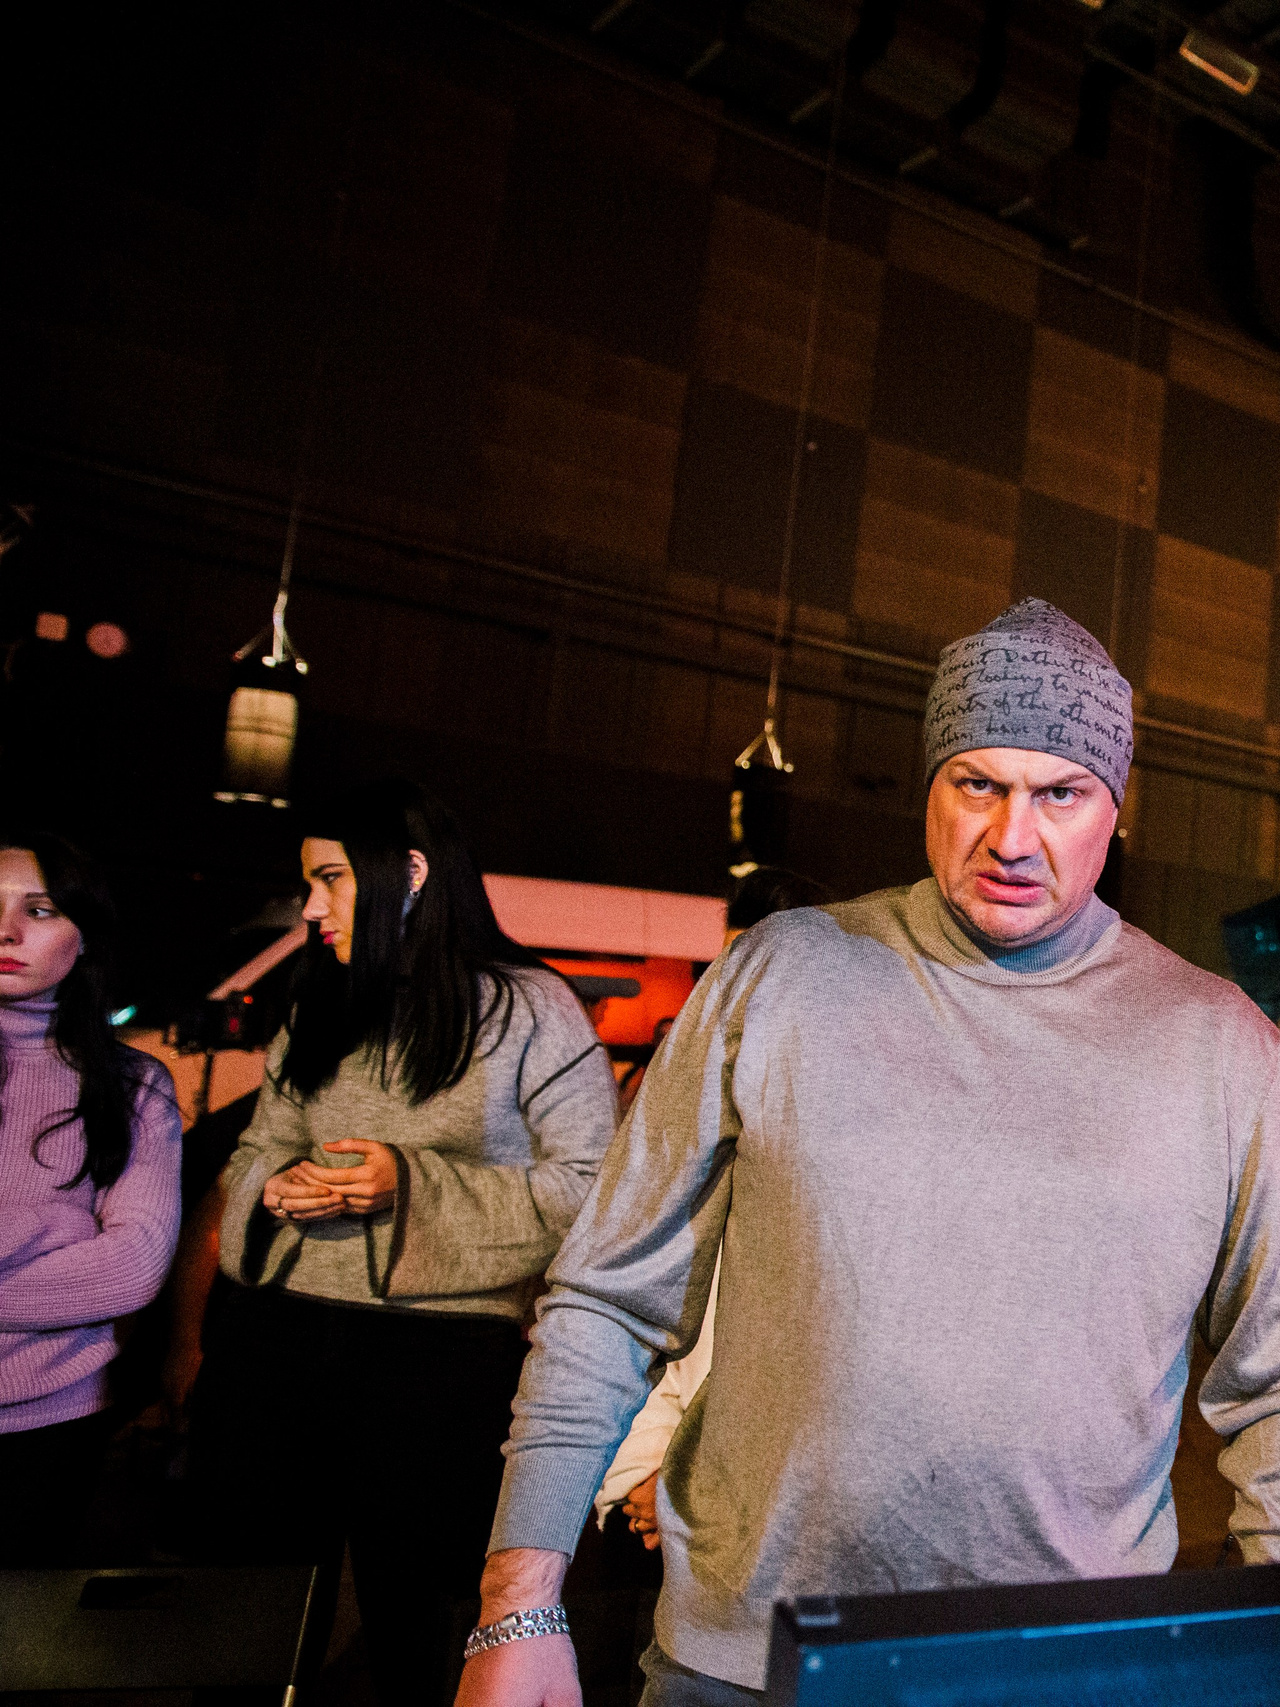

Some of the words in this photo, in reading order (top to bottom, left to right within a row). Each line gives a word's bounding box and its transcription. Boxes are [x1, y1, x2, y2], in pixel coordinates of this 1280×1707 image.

[992, 691, 1011, 717] of
[1016, 690, 1049, 711] the
[1044, 722, 1073, 748] the
